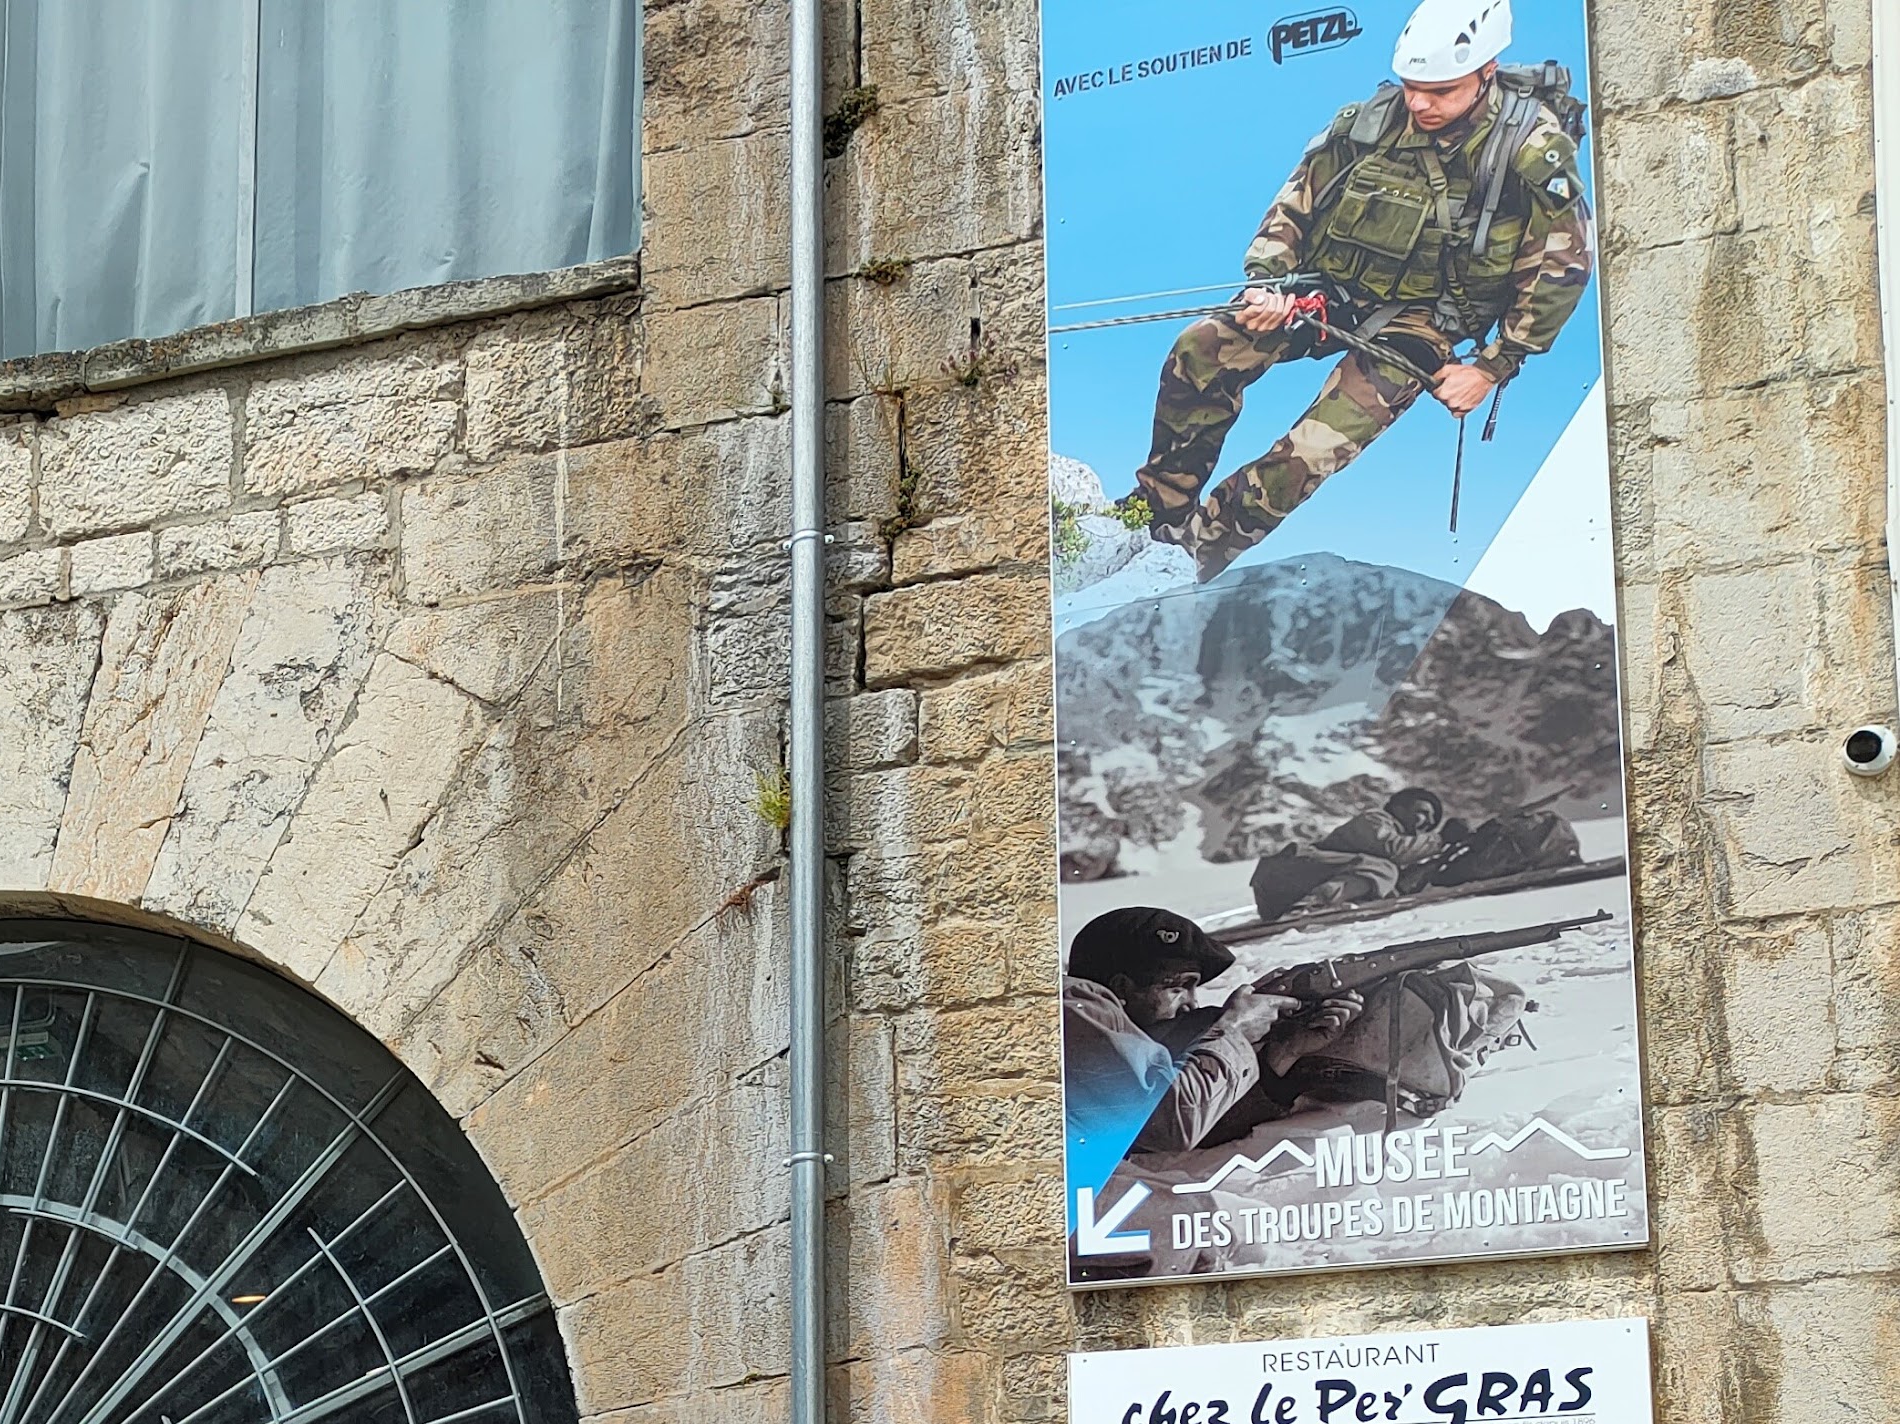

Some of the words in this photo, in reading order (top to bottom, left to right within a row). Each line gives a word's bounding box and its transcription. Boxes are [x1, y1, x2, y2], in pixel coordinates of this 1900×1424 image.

[1054, 70, 1104, 98] AVEC
[1108, 63, 1133, 86] LE
[1137, 46, 1222, 79] SOUTIEN
[1226, 37, 1252, 60] DE
[1271, 11, 1363, 65] PETZL
[1315, 1118, 1471, 1188] MUSÉE
[1171, 1209, 1232, 1250] DES
[1239, 1198, 1384, 1245] TROUPES
[1392, 1194, 1435, 1234] DE
[1443, 1178, 1628, 1230] MONTAGNE
[1262, 1342, 1440, 1373] RESTAURANT
